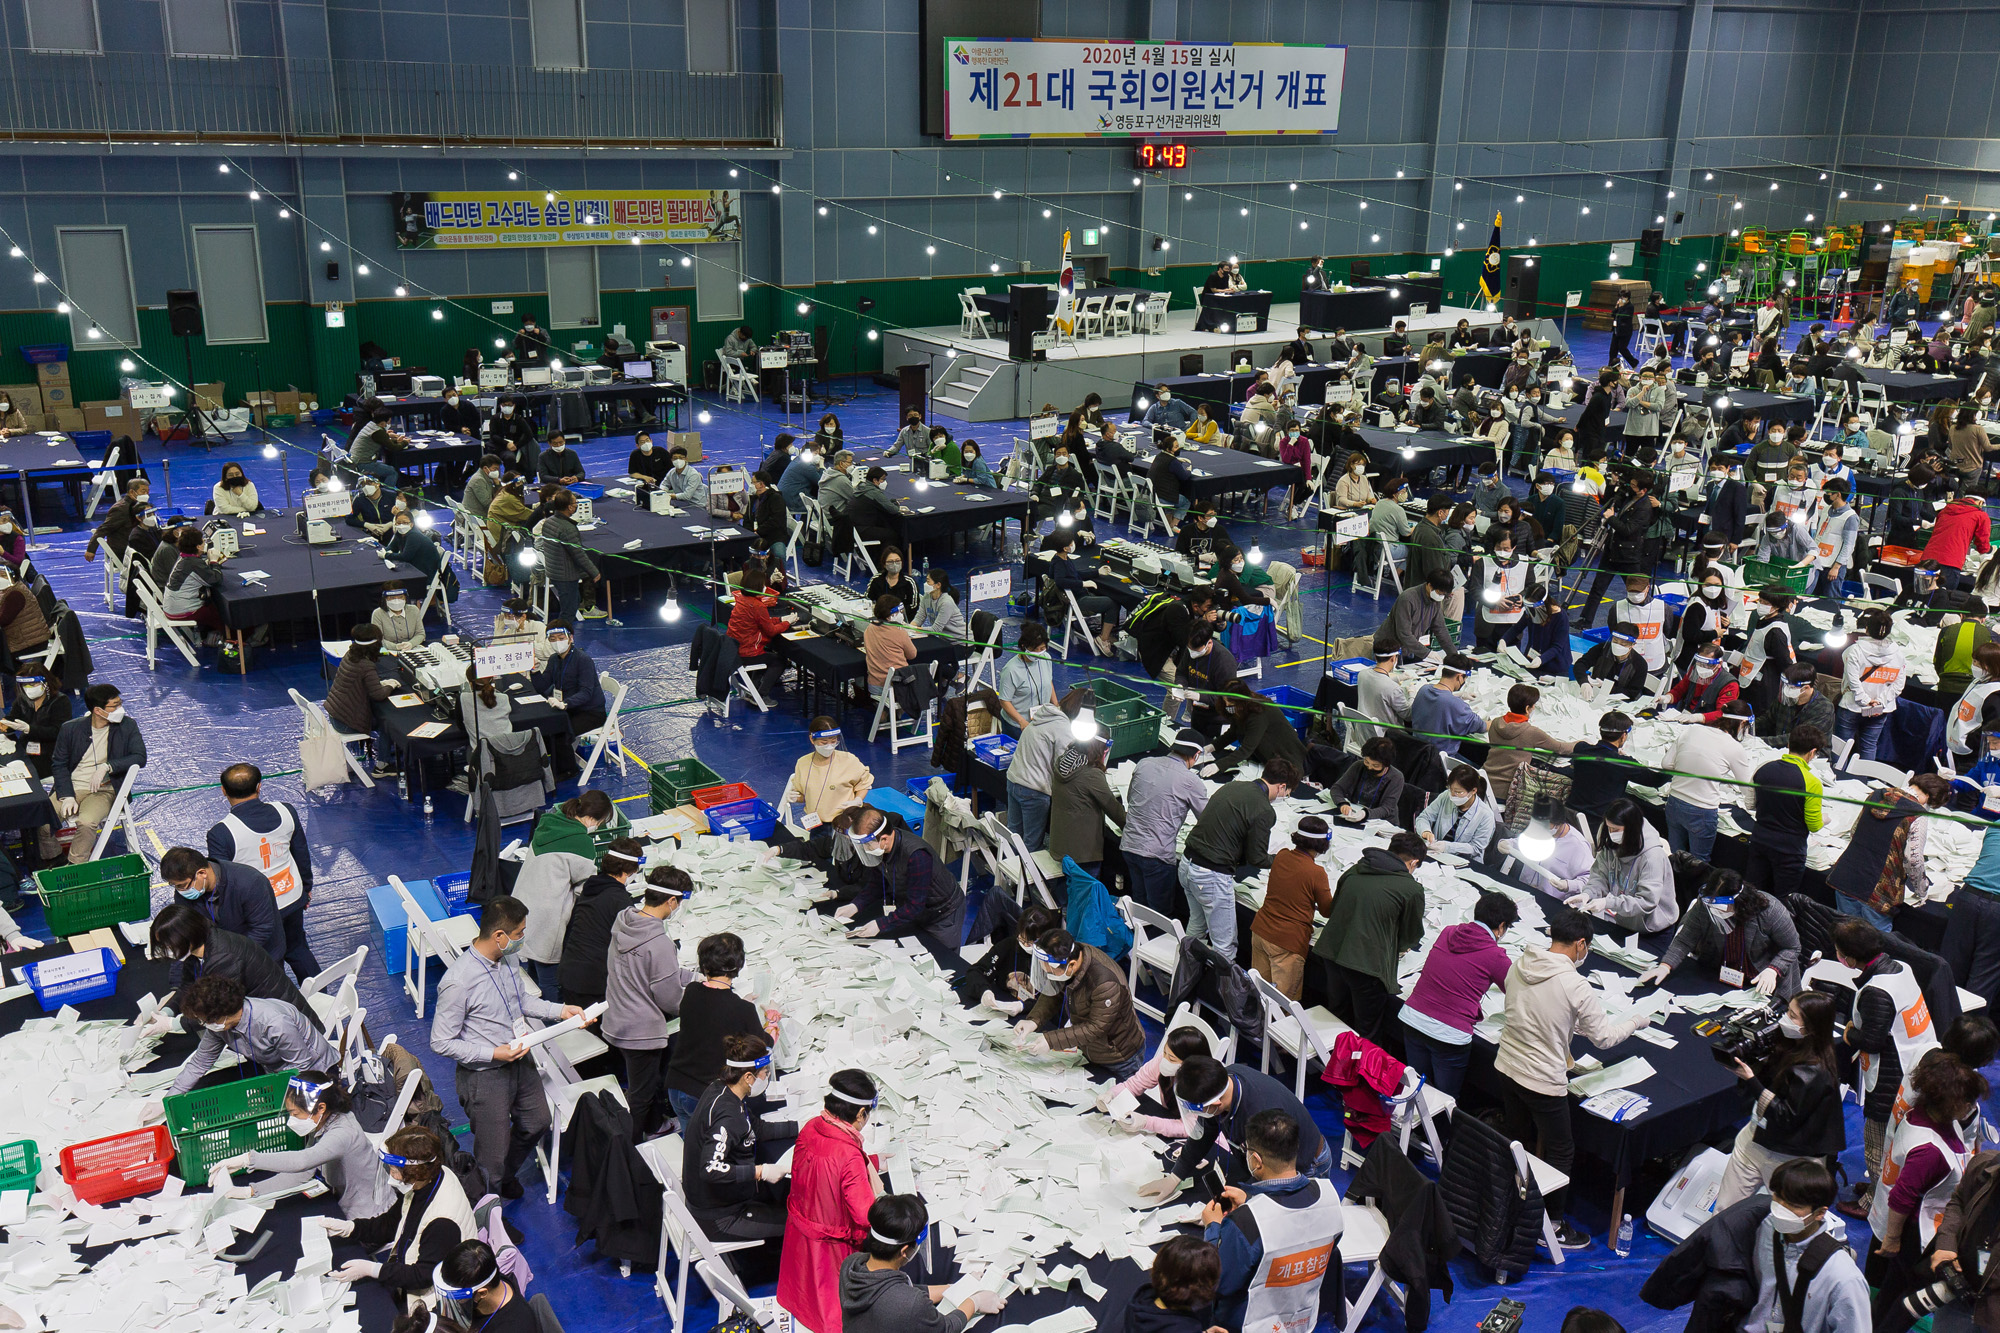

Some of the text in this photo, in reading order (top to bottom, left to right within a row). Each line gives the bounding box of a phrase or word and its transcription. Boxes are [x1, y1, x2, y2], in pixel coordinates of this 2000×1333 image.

[1082, 46, 1236, 67] 2020년 4월 15일 실시
[969, 68, 1327, 111] 제21대 국회의원선거 개표
[1115, 114, 1221, 130] 영등포구선거관리위원회
[424, 201, 482, 228] 배드민턴
[486, 201, 541, 228] 고수되는
[544, 200, 571, 226] 숨은
[613, 200, 663, 225] 배드민턴
[666, 200, 716, 224] 필라테스
